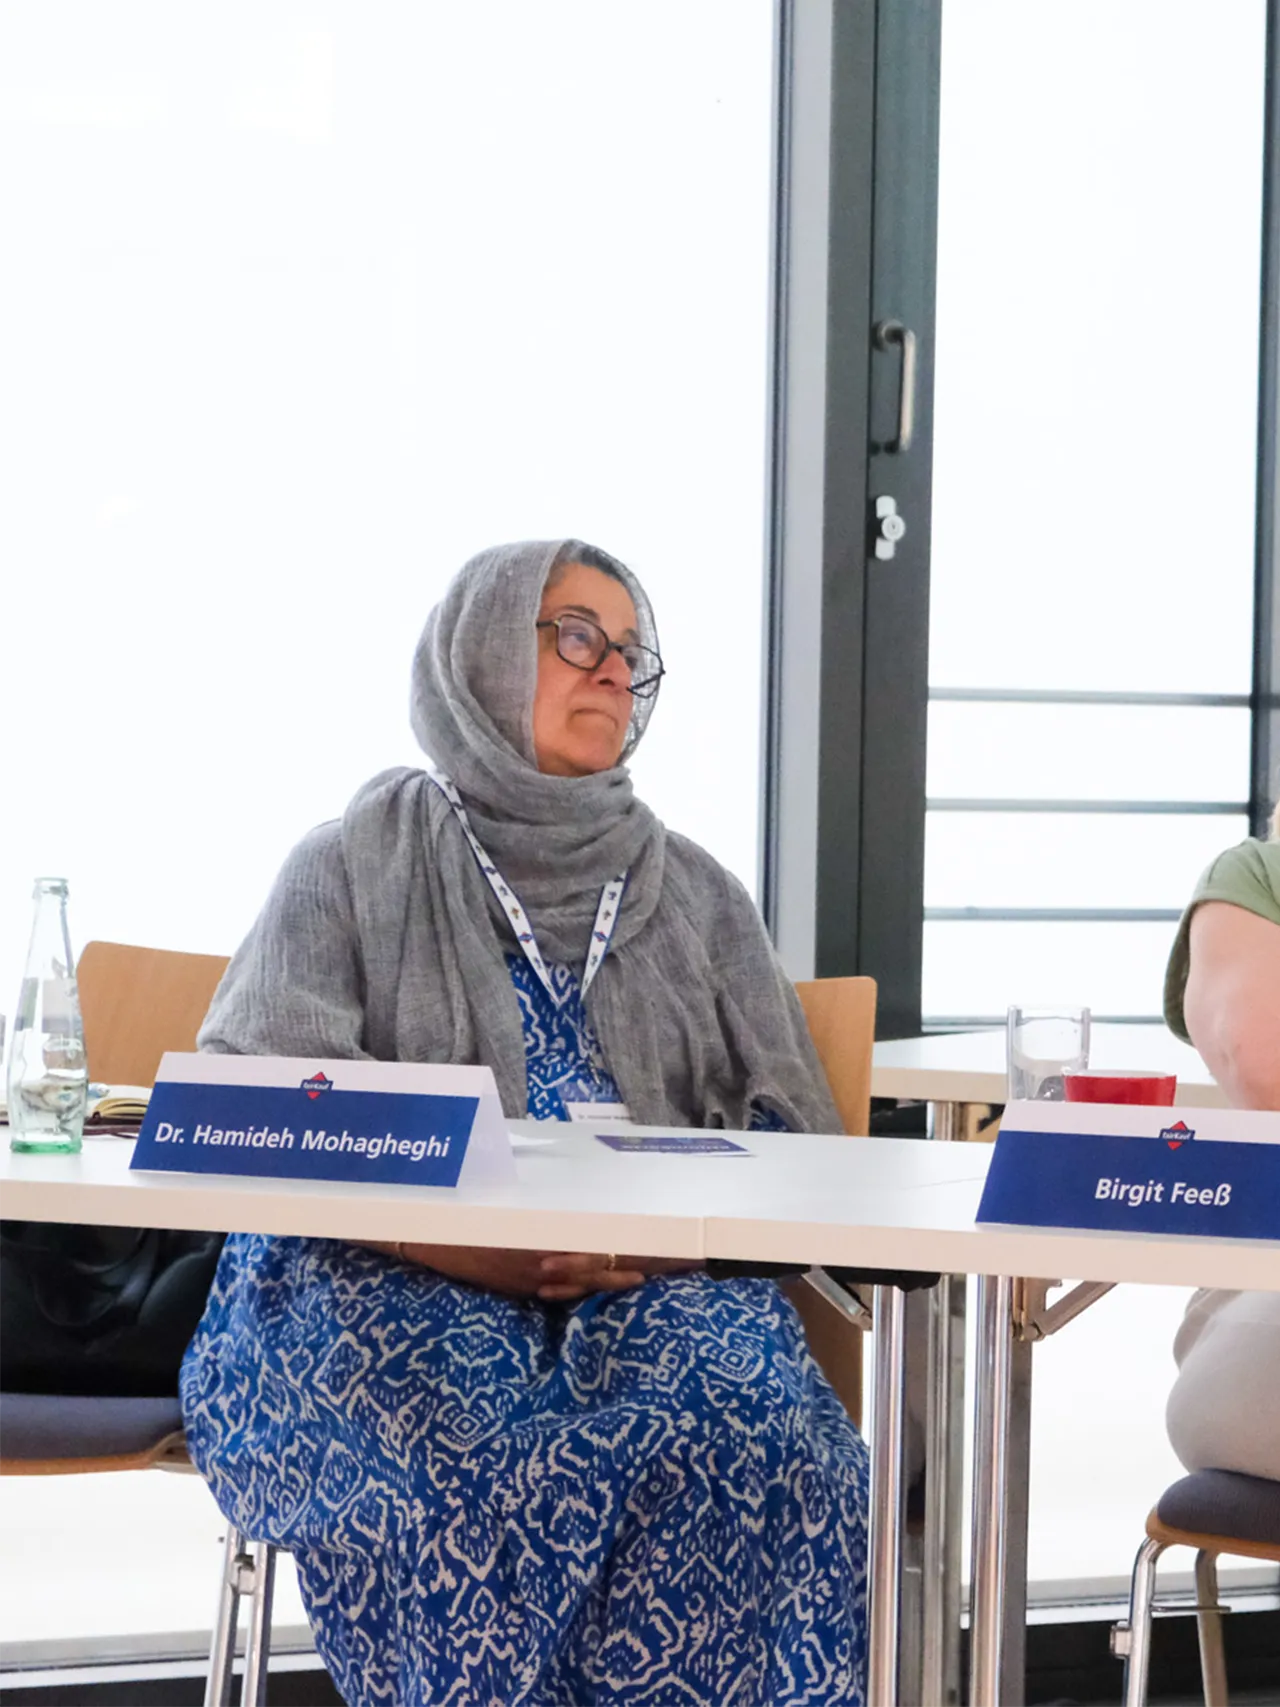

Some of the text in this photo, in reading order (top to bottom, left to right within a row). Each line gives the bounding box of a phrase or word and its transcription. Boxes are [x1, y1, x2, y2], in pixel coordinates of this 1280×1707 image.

[154, 1122, 451, 1162] Dr. Hamideh Mohagheghi
[1094, 1177, 1232, 1207] Birgit Feeß
